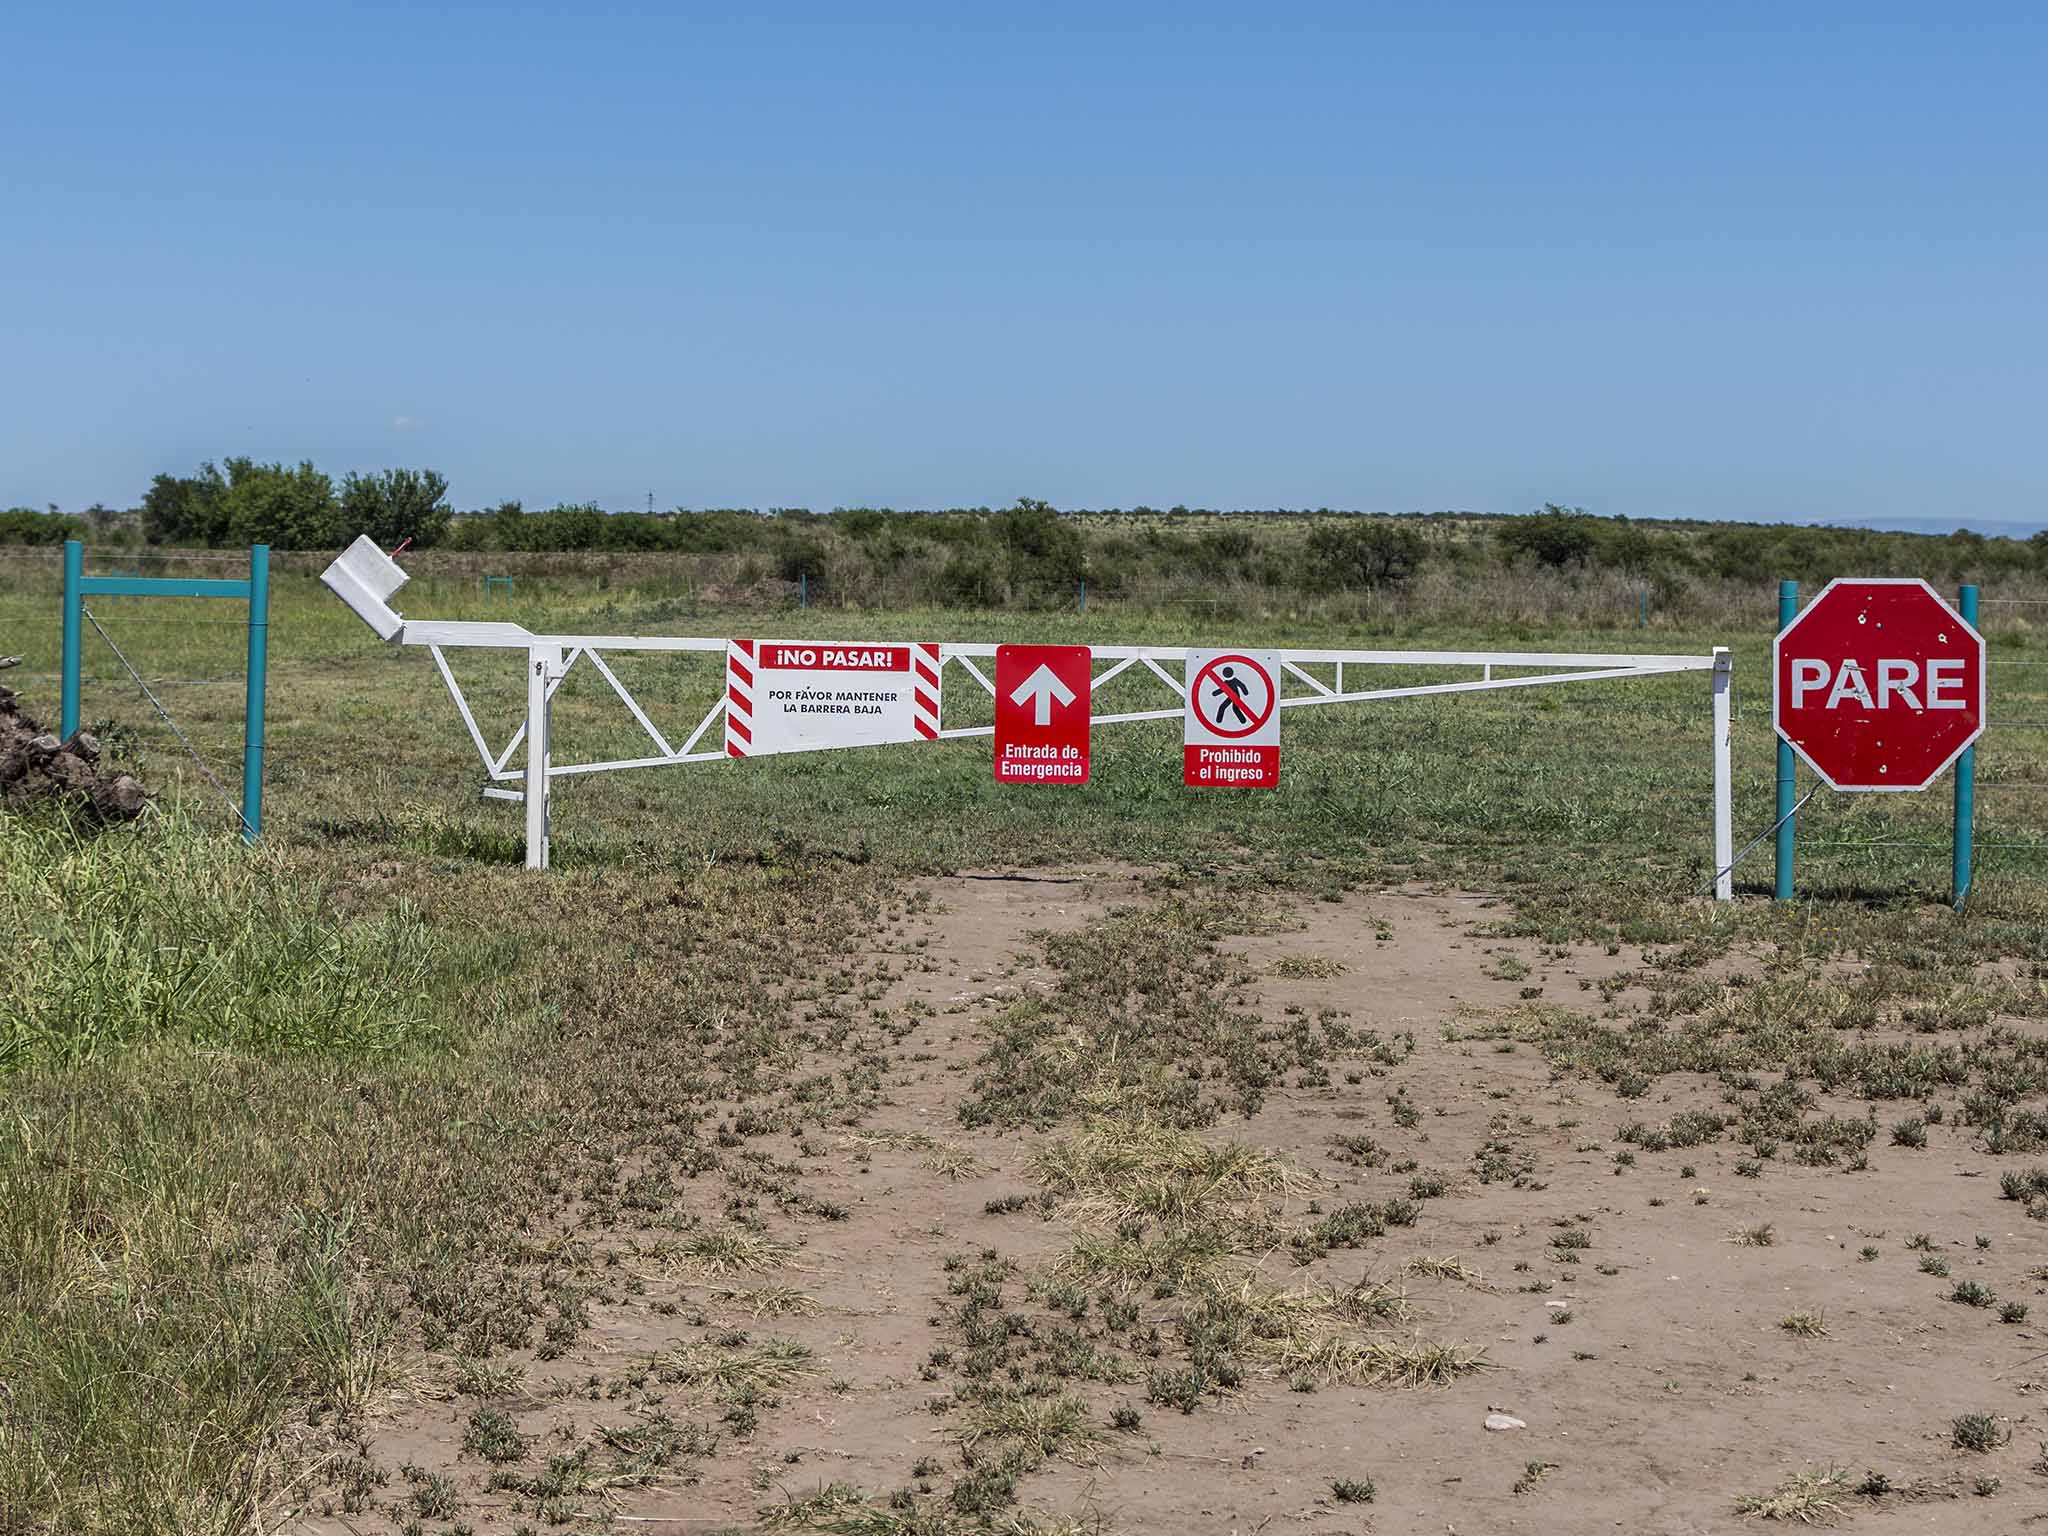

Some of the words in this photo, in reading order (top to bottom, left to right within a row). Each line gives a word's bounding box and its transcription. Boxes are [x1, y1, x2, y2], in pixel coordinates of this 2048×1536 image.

[777, 650, 816, 666] ¡NO
[823, 651, 893, 668] PASAR!
[1791, 658, 1967, 710] PARE
[769, 691, 792, 700] POR
[795, 691, 833, 701] FAVOR
[836, 692, 898, 702] MANTENER
[784, 704, 797, 713] LA
[800, 704, 851, 714] BARRERA
[854, 705, 882, 715] BAJA
[1005, 744, 1057, 759] Entrada
[1062, 745, 1079, 760] de
[1200, 749, 1261, 764] Prohibido
[1002, 761, 1082, 778] Emergencia
[1199, 765, 1212, 779] el
[1215, 766, 1264, 782] ingreso
